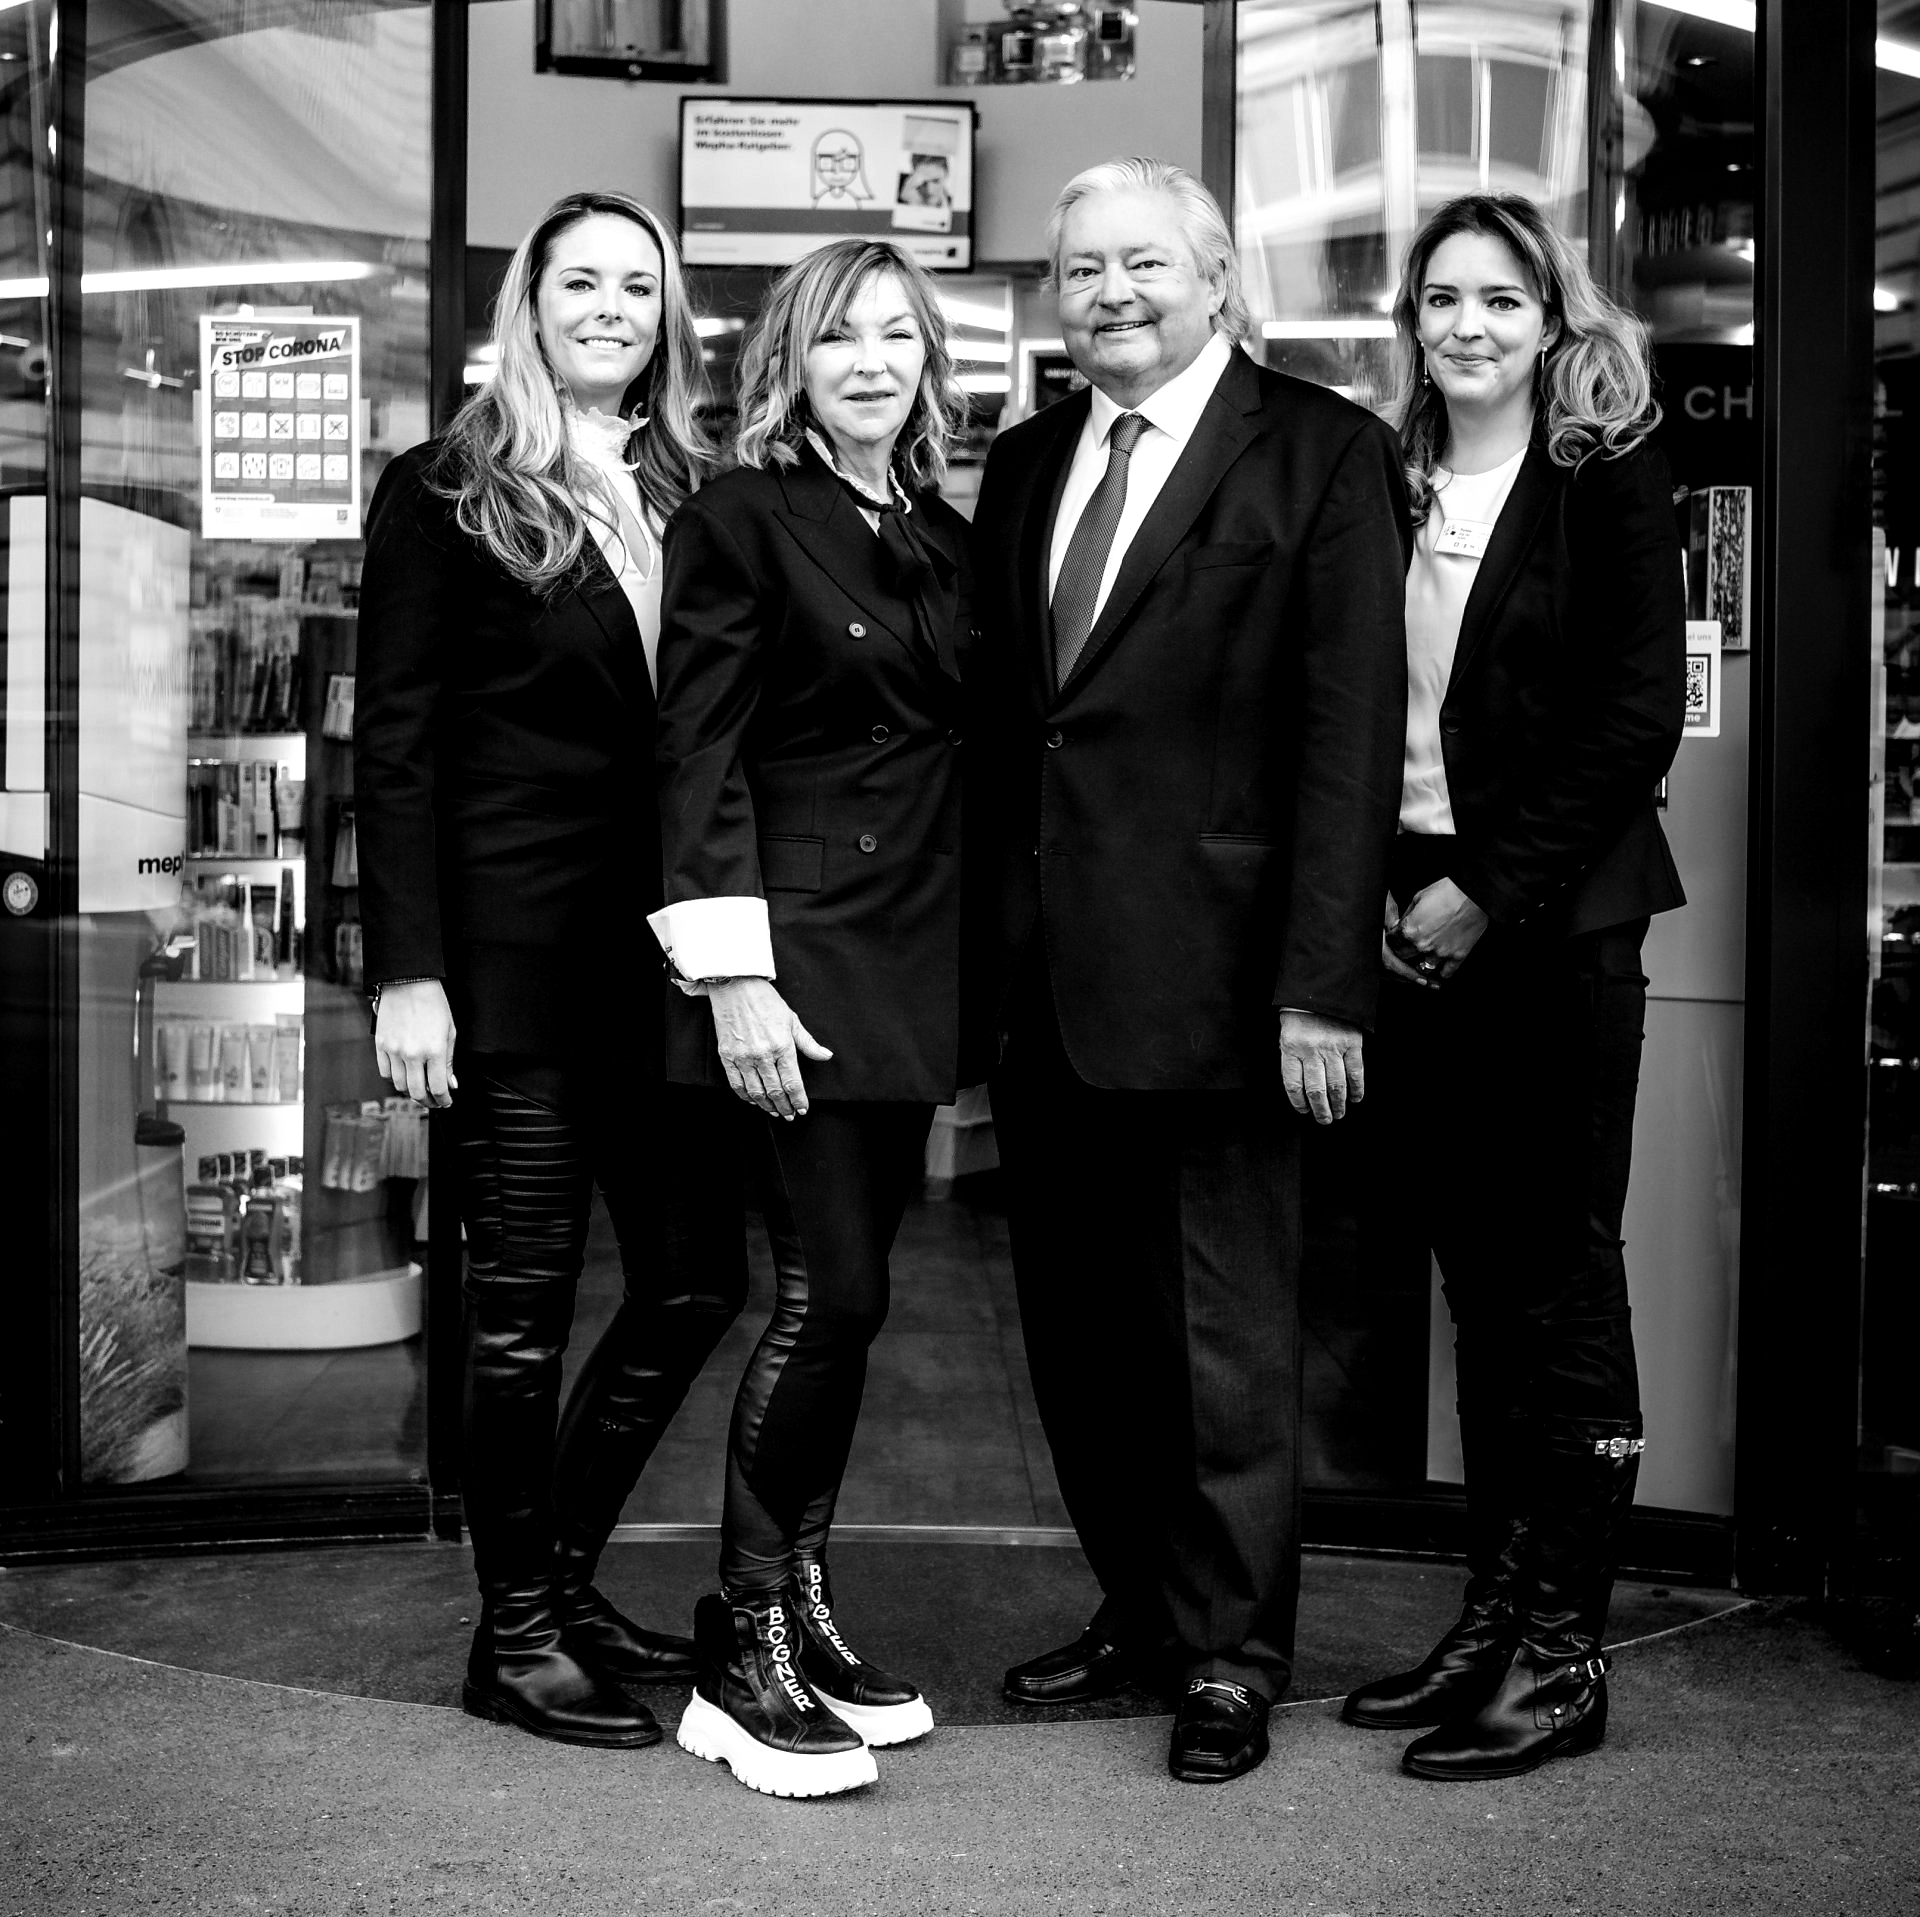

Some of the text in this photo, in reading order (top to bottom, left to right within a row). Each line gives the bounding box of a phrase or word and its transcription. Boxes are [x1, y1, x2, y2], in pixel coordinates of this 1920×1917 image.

[222, 337, 341, 366] STOP CORONA
[767, 1606, 816, 1713] BOGNER
[809, 1564, 862, 1666] BOGNER
